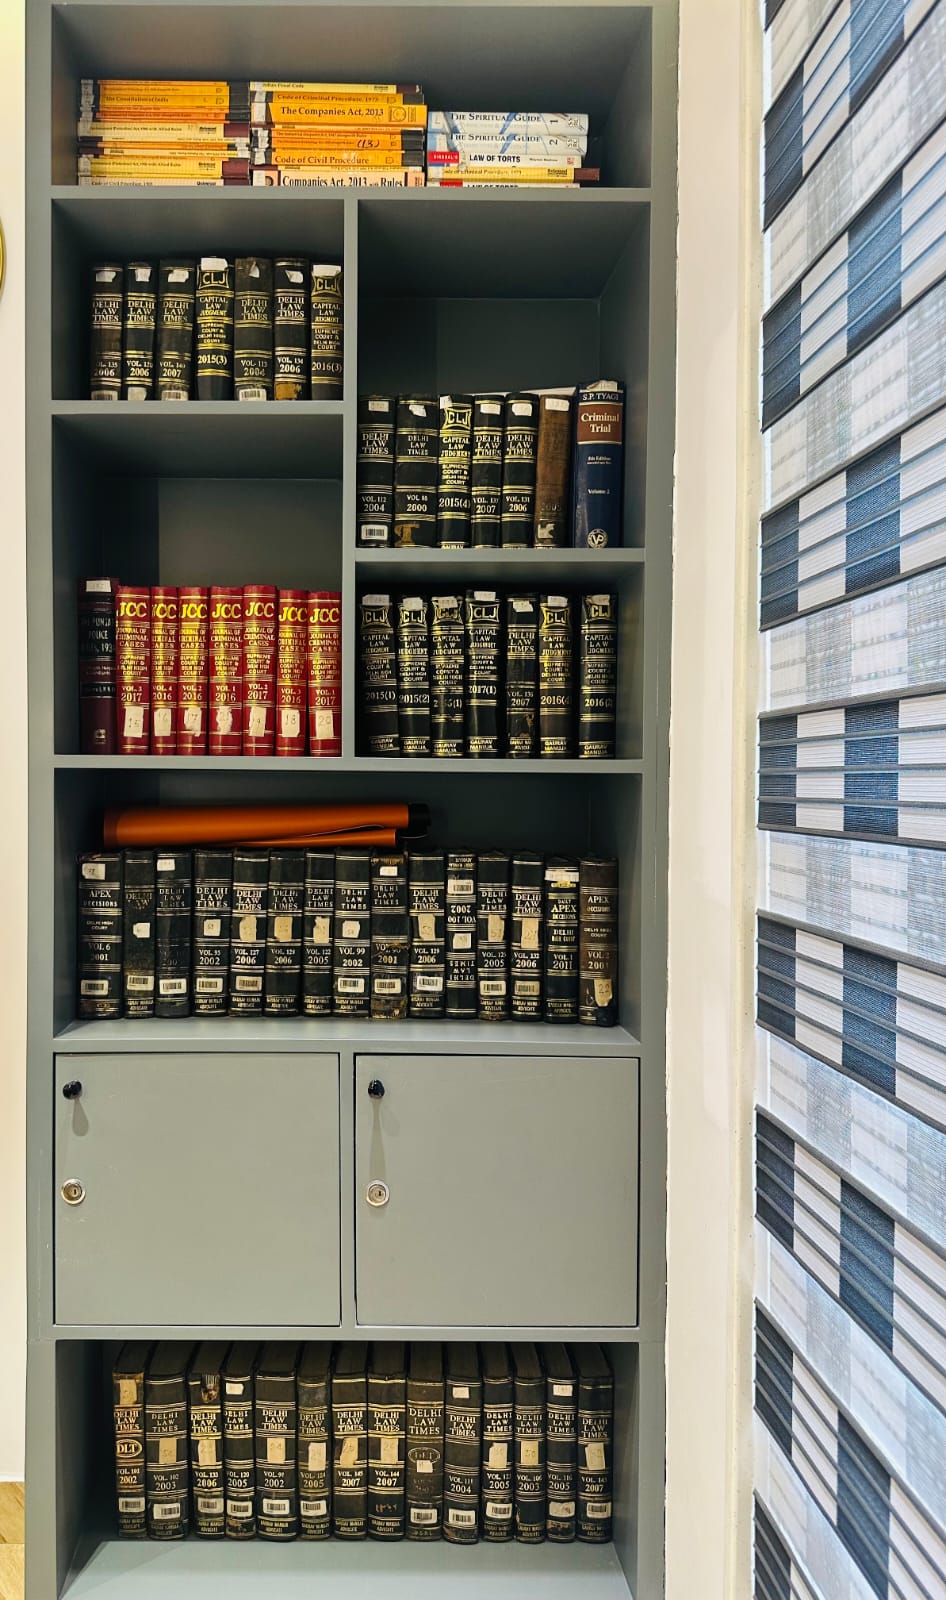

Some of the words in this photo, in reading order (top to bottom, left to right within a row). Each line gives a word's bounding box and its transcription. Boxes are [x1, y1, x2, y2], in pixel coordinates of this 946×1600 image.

[298, 107, 345, 117] Companies
[348, 108, 363, 116] Act,
[514, 114, 541, 122] GUIDE
[275, 156, 296, 164] Code
[282, 176, 328, 186] Companies
[349, 177, 367, 186] 2013
[380, 177, 402, 186] Rules
[202, 273, 226, 284] CLJ
[316, 279, 336, 291] CLJ
[198, 355, 227, 365] 2015(3)
[280, 365, 300, 373] 2006
[312, 362, 342, 372] 2016(3)
[130, 368, 149, 376] 2006
[163, 368, 181, 377] 2007
[448, 412, 468, 424] CLJ
[581, 413, 619, 422] Criminal
[590, 424, 611, 432] Trial
[439, 497, 470, 508] 2015(4)
[476, 505, 496, 514] 2007
[509, 504, 527, 512] 2006
[120, 602, 147, 617] JCC
[182, 604, 207, 618] JCC
[212, 604, 241, 618] JCC
[245, 602, 274, 617] JCC
[474, 607, 497, 618] CLJ
[591, 606, 610, 617] CLJ
[278, 607, 307, 622] JCC
[310, 608, 339, 623] JCC
[403, 611, 423, 622] CLJ
[546, 612, 566, 623] CLJ
[121, 693, 142, 702] 2017
[183, 692, 202, 701] 2016
[216, 693, 236, 702] 2016
[248, 691, 268, 700] 2017
[282, 696, 301, 704] 2016
[366, 691, 396, 701] 2015(1)
[399, 694, 430, 704] 2015(2)
[315, 696, 335, 705] 2017
[199, 957, 220, 965] 2002
[236, 956, 256, 964] 2006
[516, 960, 537, 968] 2006
[409, 1408, 441, 1417] DELHI
[414, 1418, 436, 1426] LAW
[409, 1426, 440, 1435] TIMES
[117, 1445, 137, 1453] DLT
[120, 1476, 137, 1484] 2002
[197, 1479, 217, 1487] 2006
[264, 1479, 285, 1488] 2002
[376, 1478, 397, 1486] 2007
[156, 1481, 176, 1491] 2003
[450, 1484, 471, 1493] 2004
[489, 1481, 510, 1489] 2005
[549, 1482, 570, 1490] 2005
